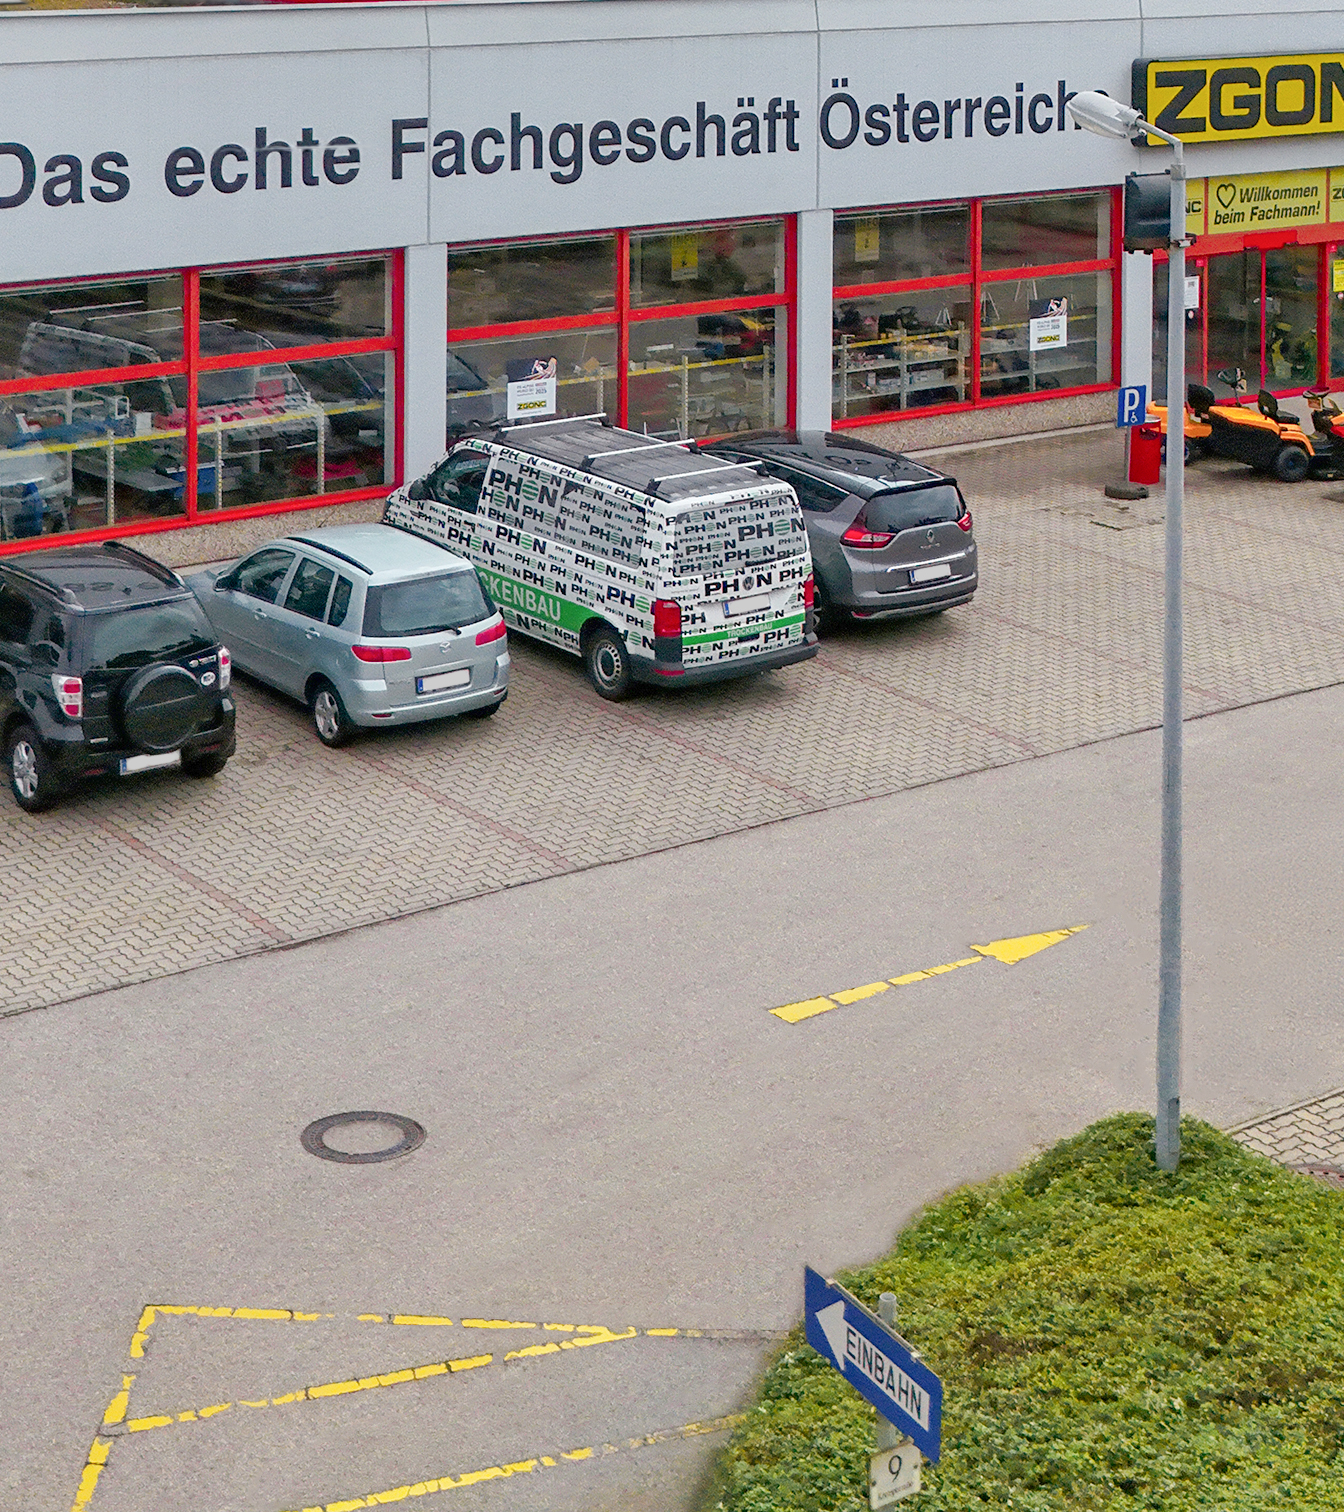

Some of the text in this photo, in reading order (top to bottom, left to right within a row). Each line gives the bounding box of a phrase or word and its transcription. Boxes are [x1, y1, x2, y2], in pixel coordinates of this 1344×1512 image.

[164, 127, 360, 197] echte
[392, 96, 799, 184] Fachgeschäft
[820, 78, 1109, 150] Österreich
[1240, 186, 1318, 203] Willkommen
[1214, 201, 1320, 225] beim Fachmann!
[1125, 388, 1139, 420] P
[726, 623, 772, 637] TROCKENBAU
[846, 1326, 921, 1420] EINBAHN
[888, 1454, 902, 1483] 9
